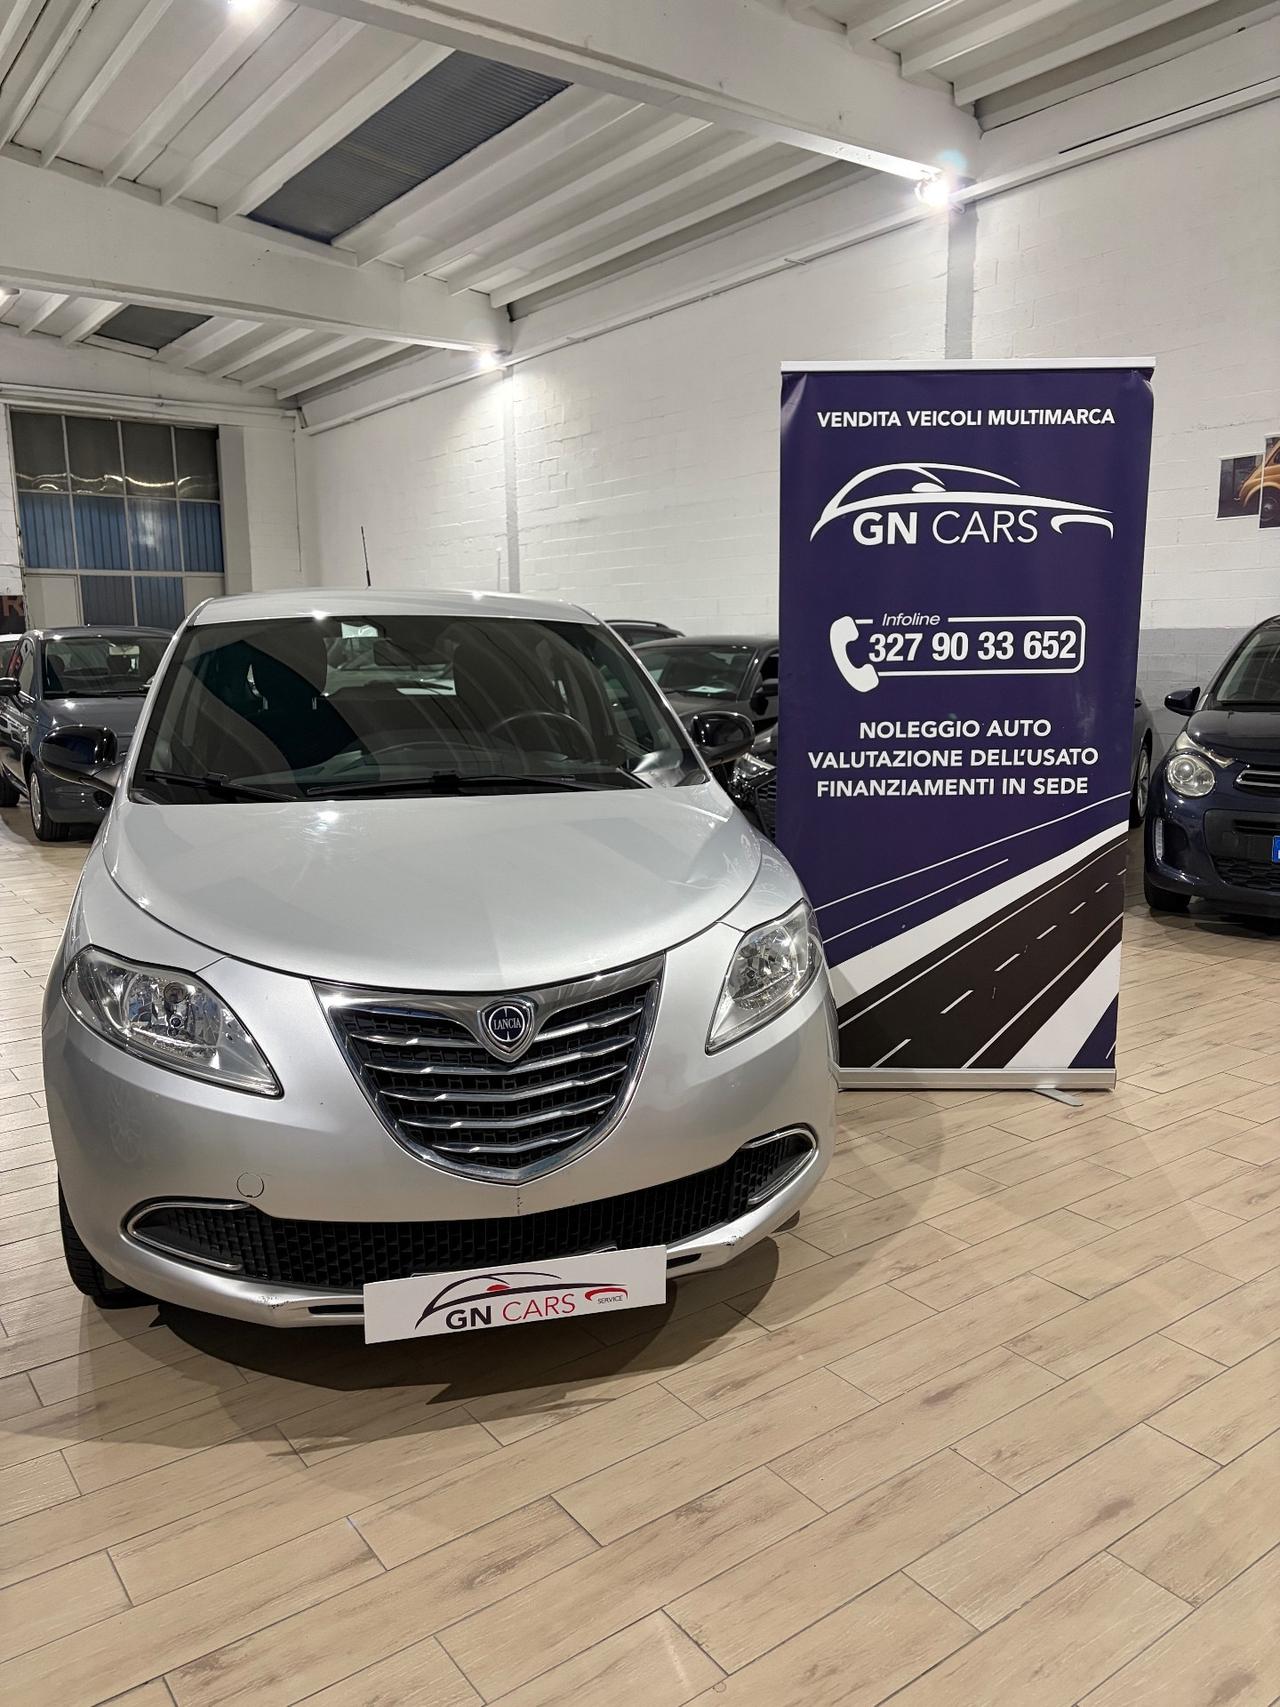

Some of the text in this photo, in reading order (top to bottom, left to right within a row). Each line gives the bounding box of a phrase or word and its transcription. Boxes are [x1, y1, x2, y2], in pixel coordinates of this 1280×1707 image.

[817, 409, 1115, 427] VENDITA VEICOLI MULTIMARCA
[853, 510, 1038, 545] GN CARS
[882, 613, 940, 626] Infoline
[869, 630, 1076, 662] 327 90 33 652
[860, 719, 1051, 739] NOLEGGIO AUTO
[808, 748, 1098, 768] VALUTAZIONE DELL'USATO
[817, 777, 1088, 797] FINANZIAMENTI IN SEDE
[493, 1017, 522, 1030] LANCIA
[445, 1293, 623, 1330] GN CARS SERVICE
